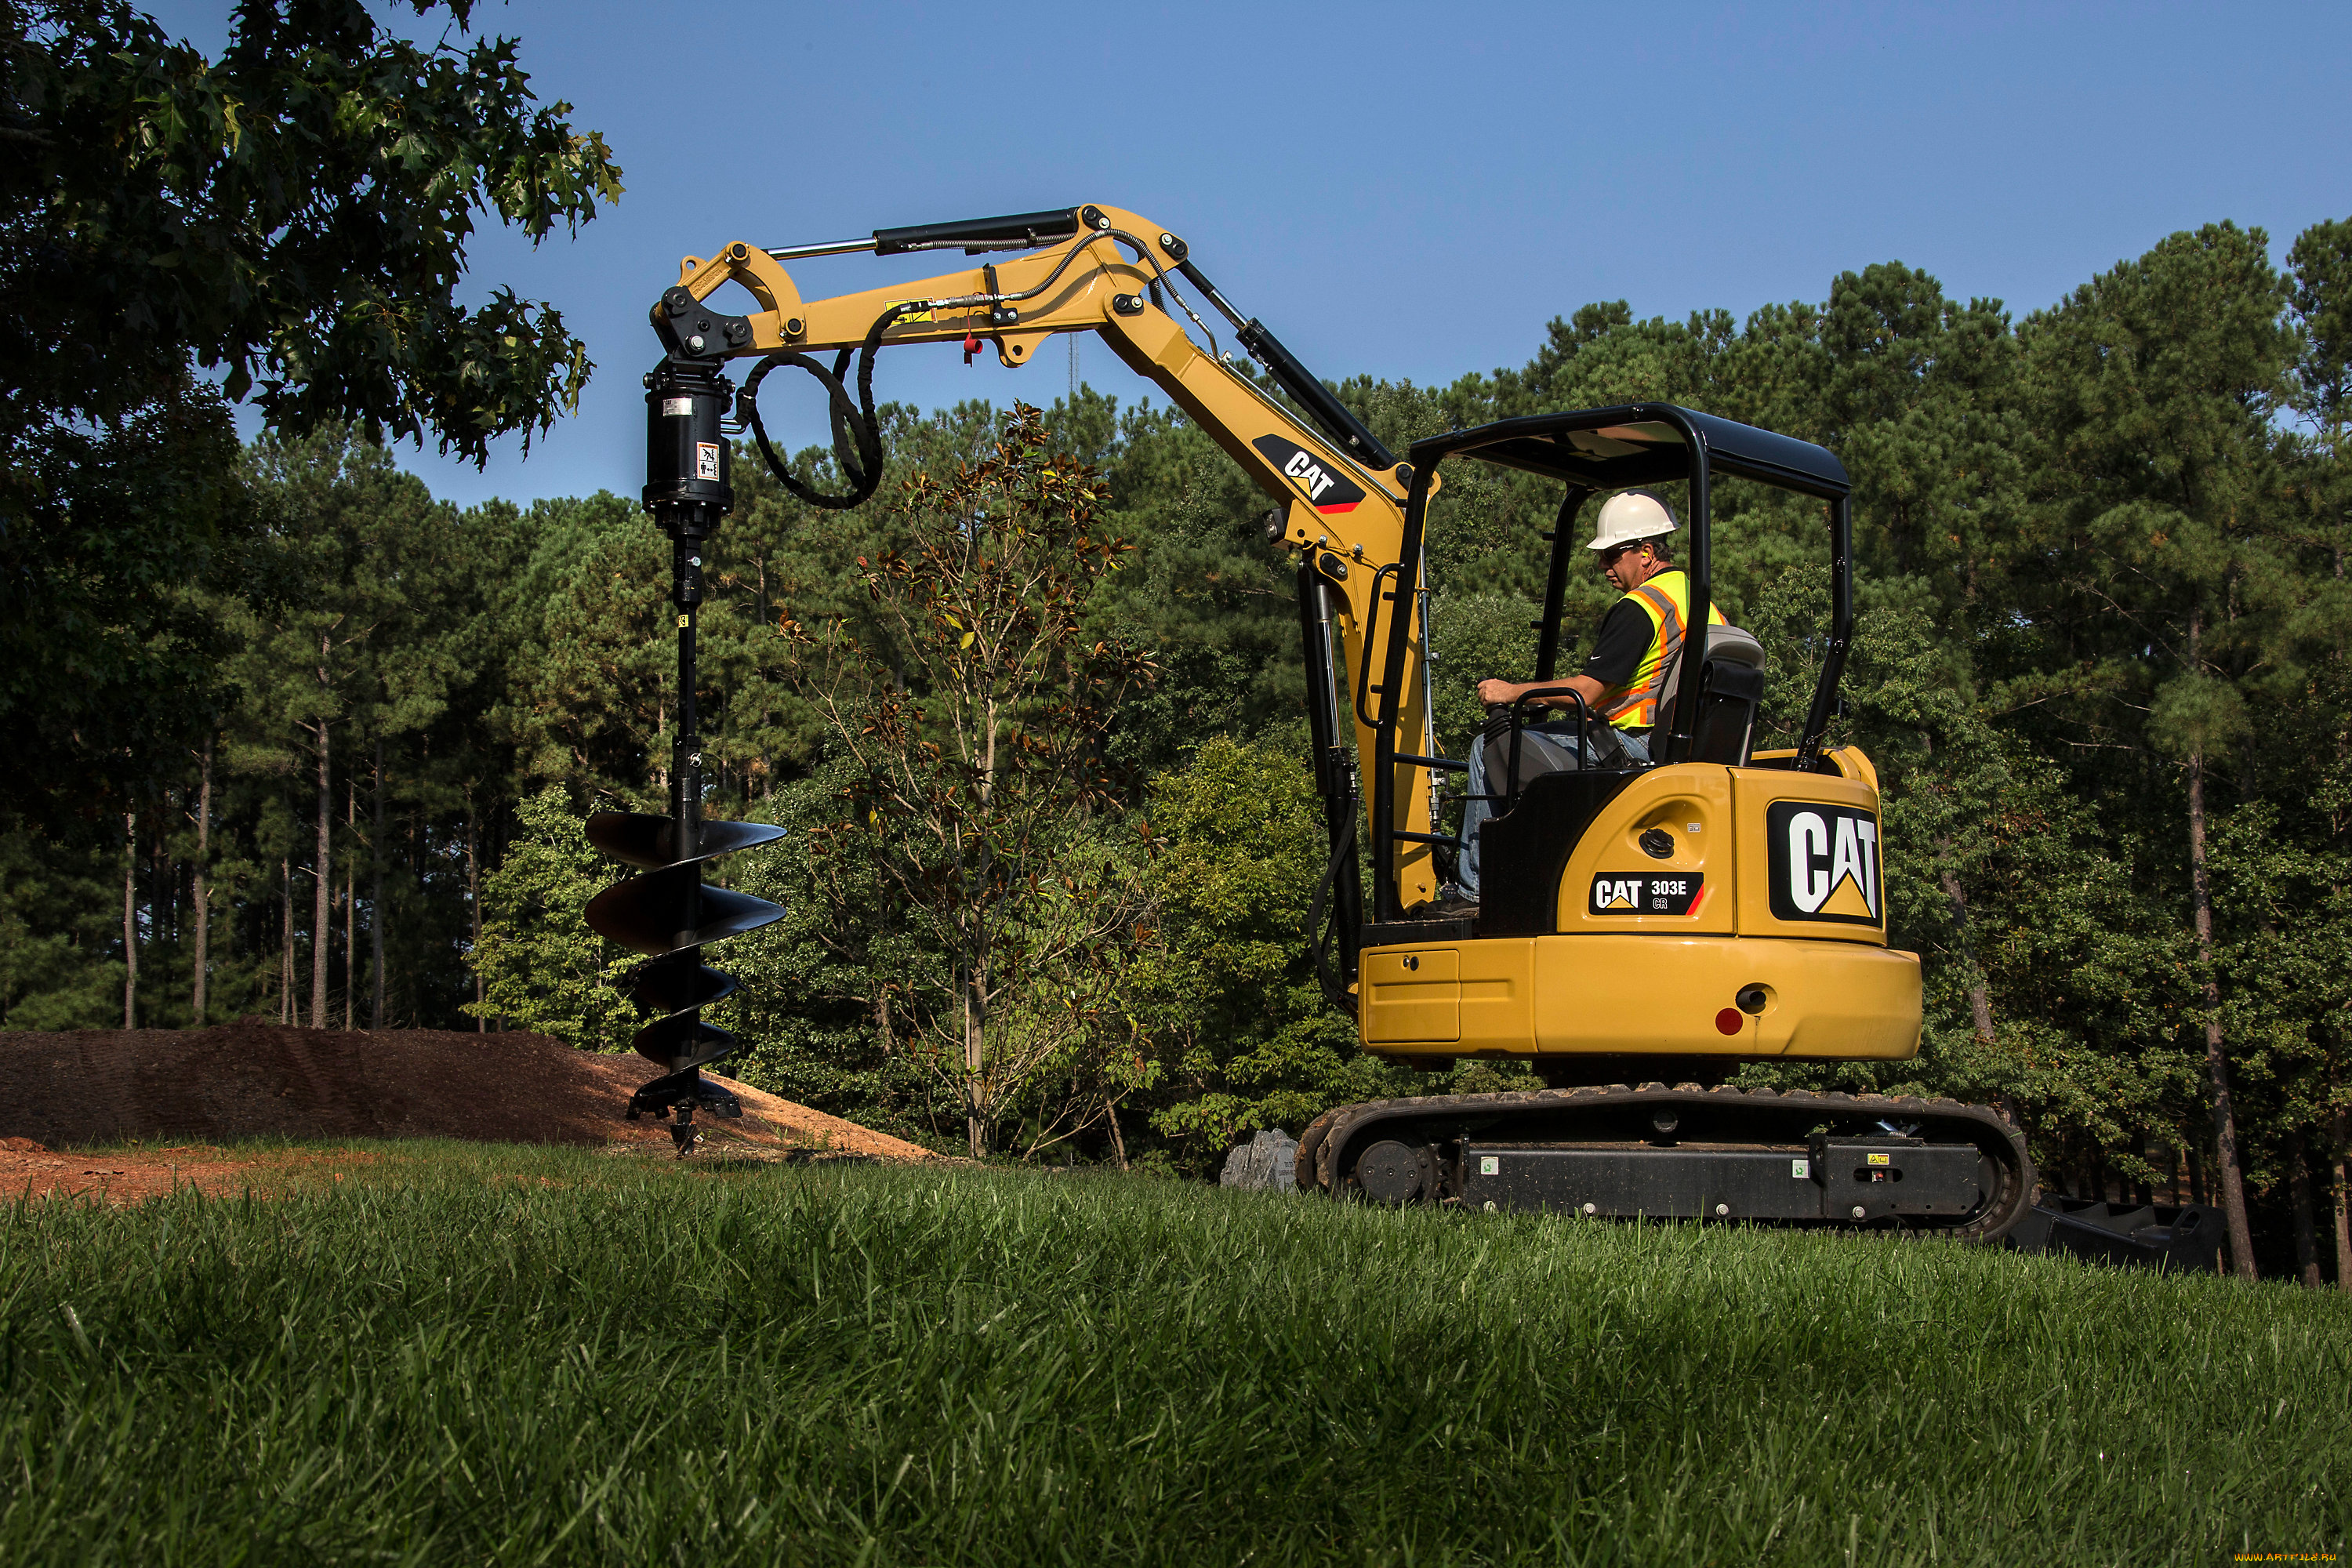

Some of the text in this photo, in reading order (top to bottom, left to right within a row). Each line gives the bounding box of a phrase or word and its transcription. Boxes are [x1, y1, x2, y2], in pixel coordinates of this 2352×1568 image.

[1284, 451, 1334, 501] CAT
[1788, 811, 1876, 918] CAT
[1595, 880, 1686, 909] CAT 303E
[1653, 898, 1668, 909] CR
